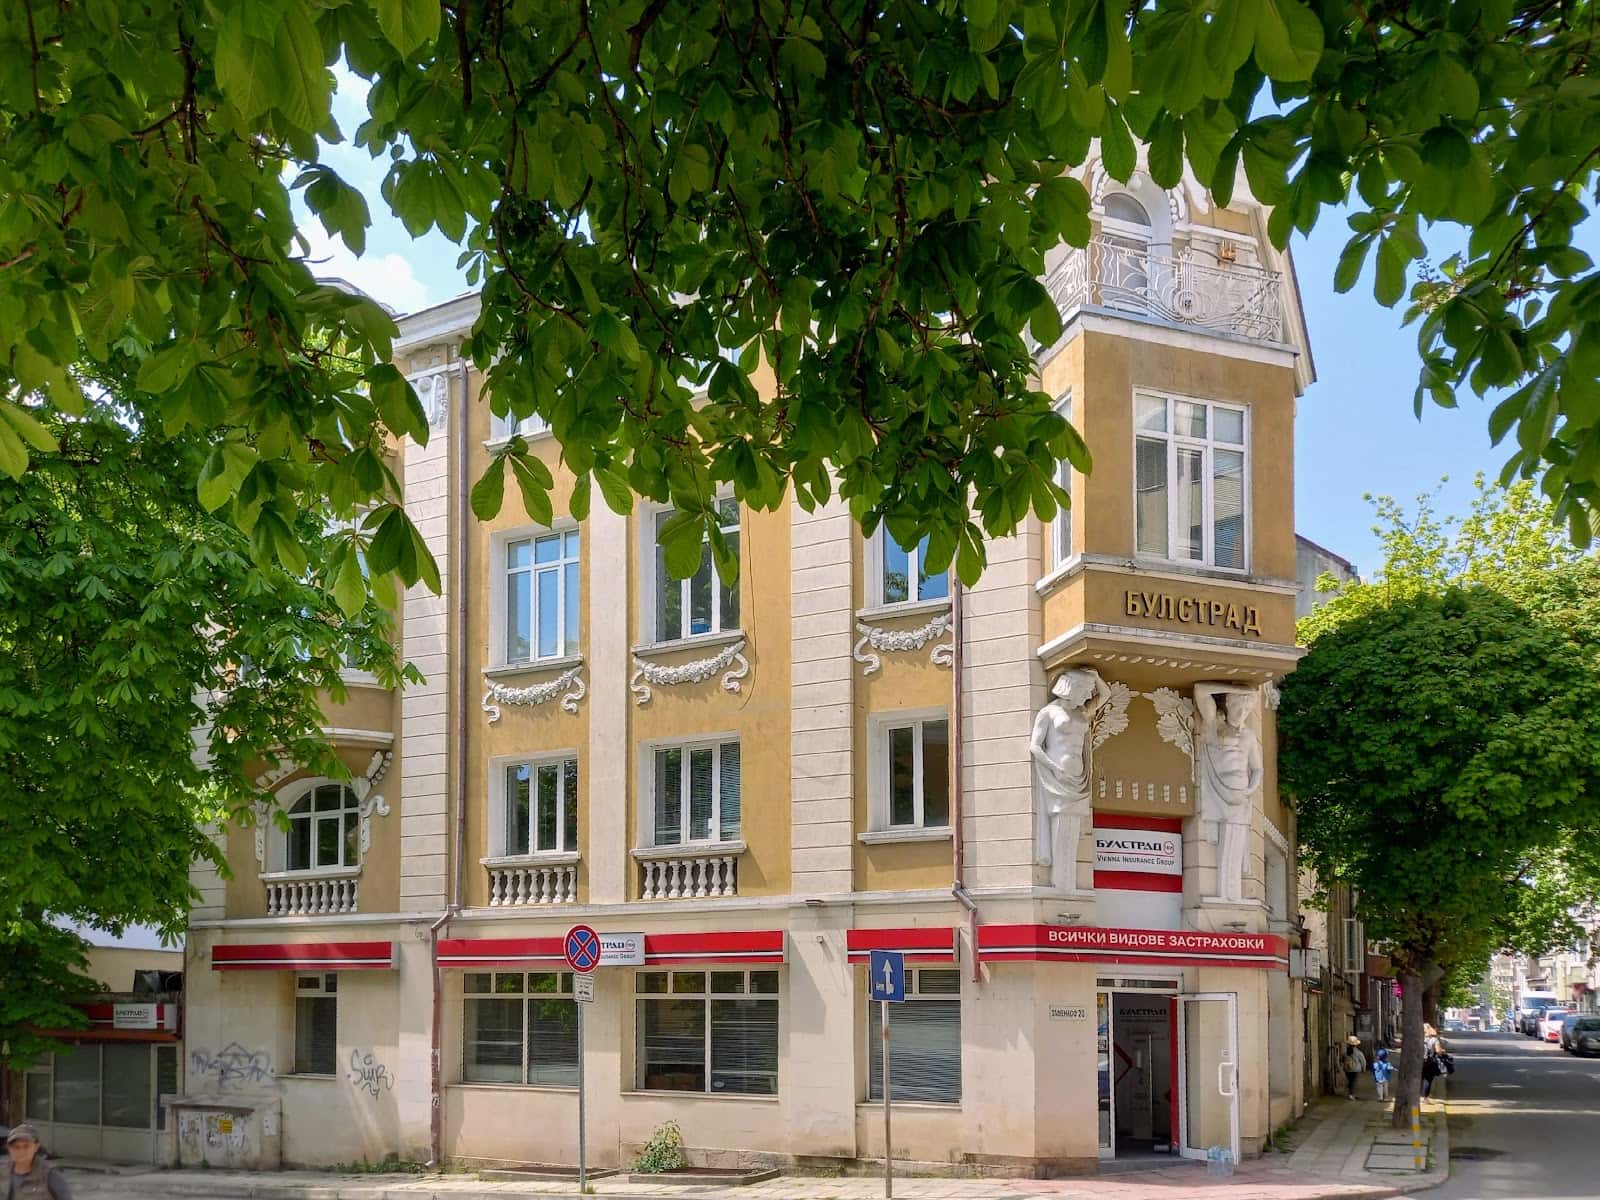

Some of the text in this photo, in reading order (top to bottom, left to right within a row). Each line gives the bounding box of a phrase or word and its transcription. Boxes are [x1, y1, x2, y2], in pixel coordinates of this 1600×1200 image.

[1125, 590, 1262, 637] БУЛСТРАД
[1096, 839, 1162, 852] БУЛСТРАД
[1048, 930, 1264, 949] ВСИЧКИ ВИДОВЕ ЗАСТРАХОВКИ
